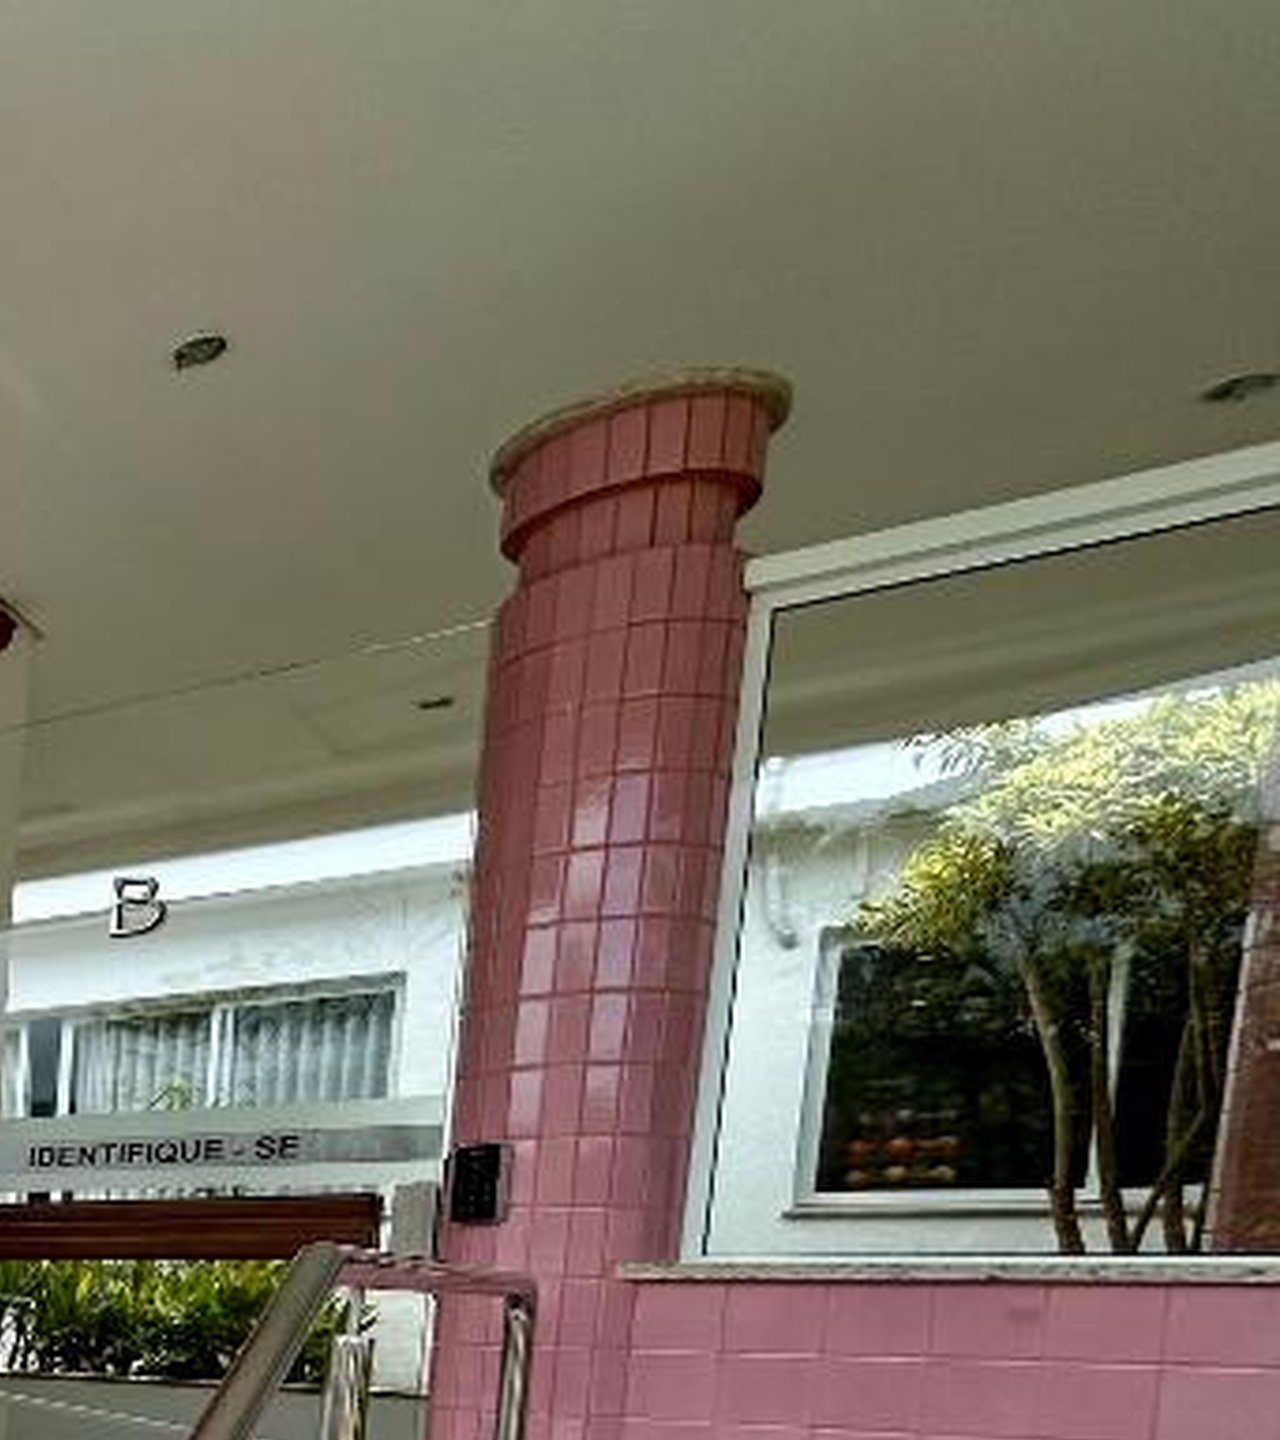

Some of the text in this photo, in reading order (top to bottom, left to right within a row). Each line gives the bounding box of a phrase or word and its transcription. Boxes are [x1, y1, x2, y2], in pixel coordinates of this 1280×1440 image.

[109, 877, 167, 938] B
[28, 1138, 224, 1168] IDENTIFIQUE
[255, 1135, 300, 1161] SE
